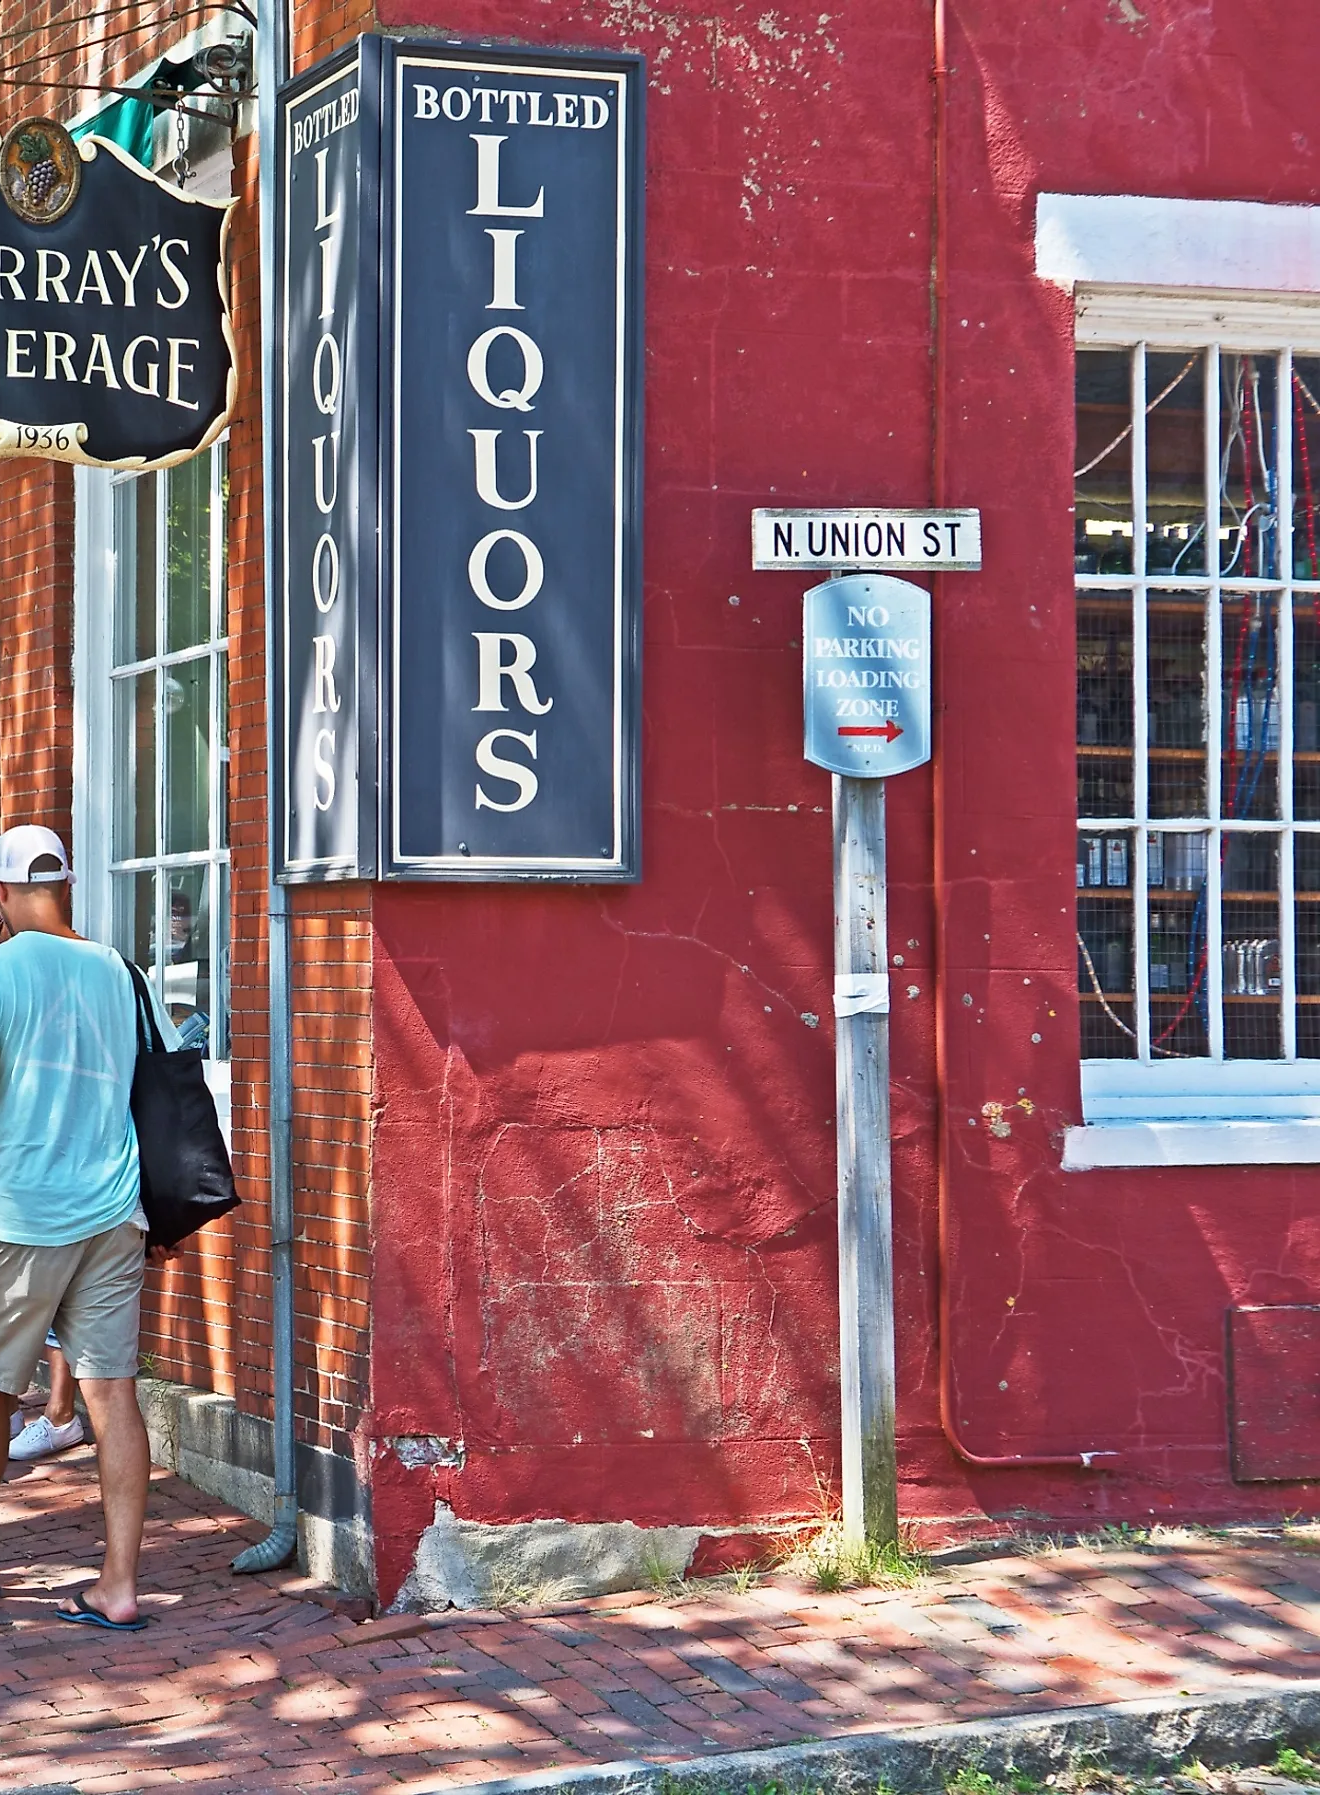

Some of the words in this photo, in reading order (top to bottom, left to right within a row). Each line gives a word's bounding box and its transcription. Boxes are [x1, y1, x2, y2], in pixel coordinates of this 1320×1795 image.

[293, 87, 359, 155] BOTTLED
[413, 84, 610, 130] BOTTLED
[15, 425, 70, 450] 1936
[312, 147, 341, 811] LIQUORS
[465, 133, 554, 812] LIQUORS
[922, 522, 961, 557] ST
[847, 605, 890, 628] NO
[813, 637, 921, 660] PARKING
[815, 669, 921, 689] LOADING
[835, 699, 899, 717] ZONE
